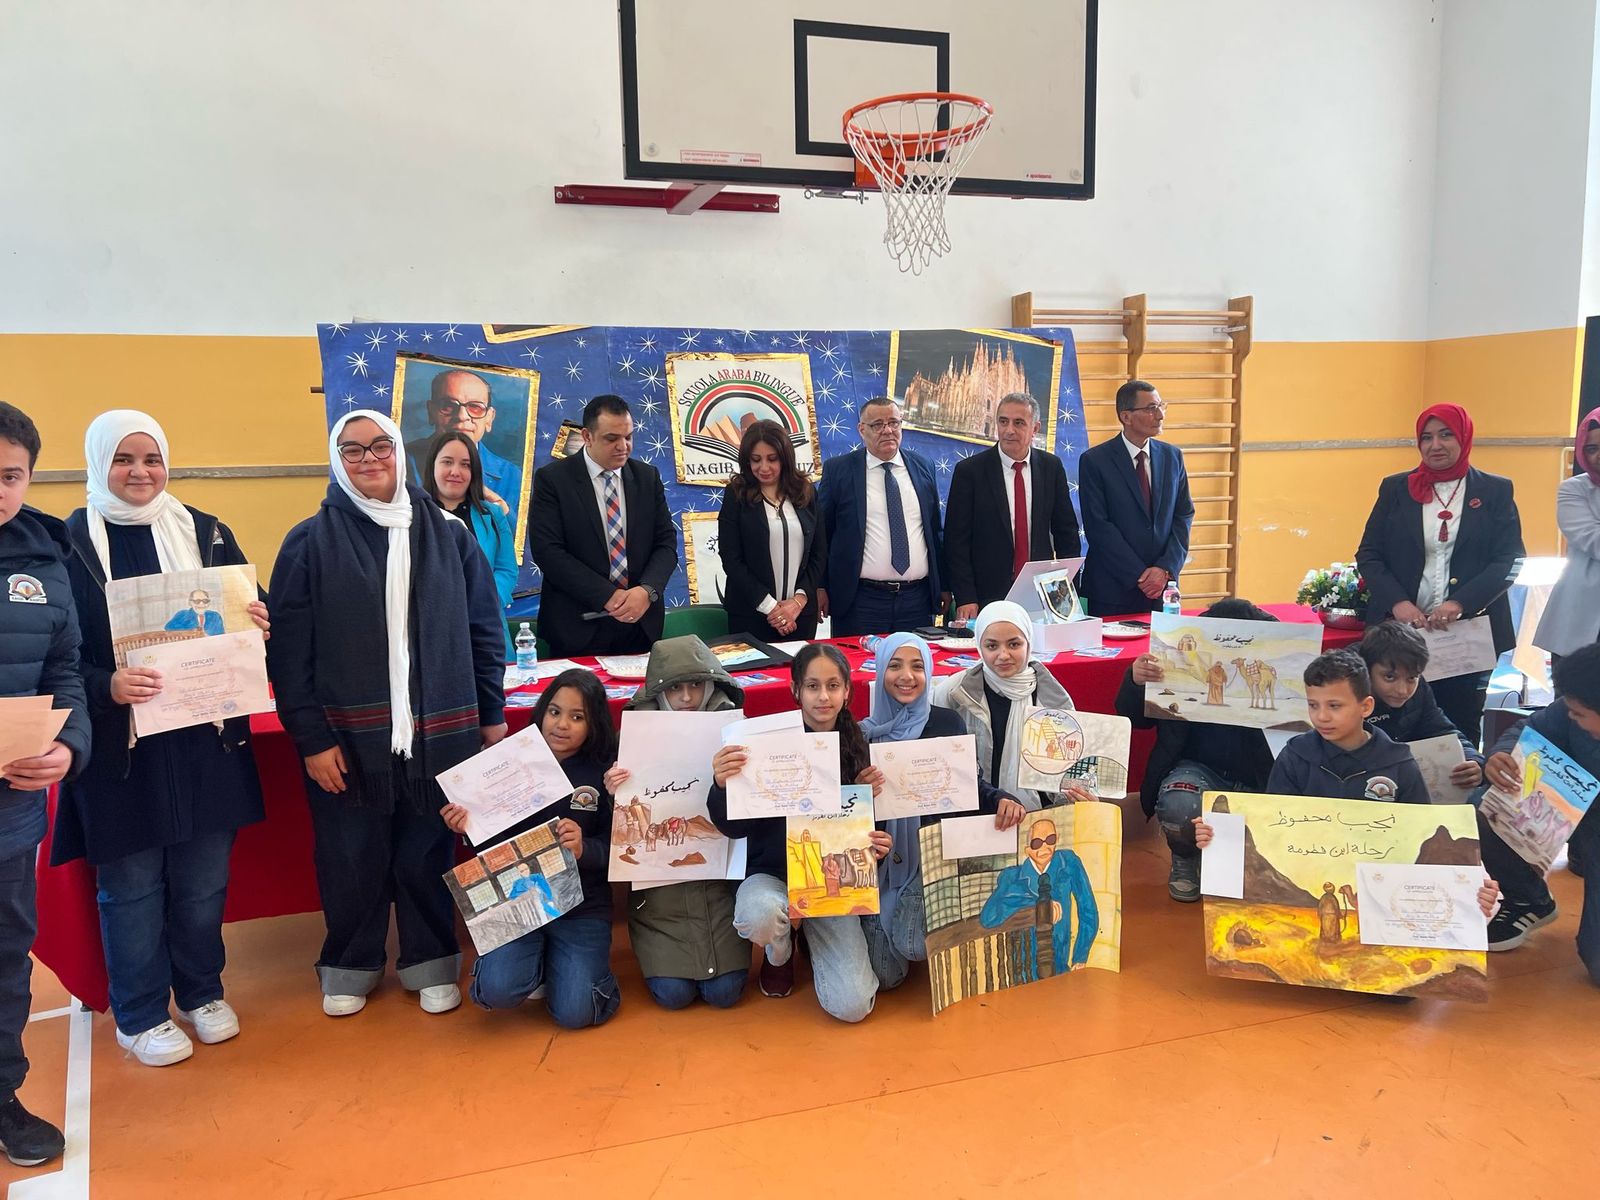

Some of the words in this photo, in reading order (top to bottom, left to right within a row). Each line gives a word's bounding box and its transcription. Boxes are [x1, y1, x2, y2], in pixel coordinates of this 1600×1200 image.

[678, 373, 719, 408] SCUOLA
[717, 369, 752, 381] ARABA
[753, 370, 806, 408] BILINGUE
[686, 461, 734, 475] NAGIB
[841, 793, 859, 813] نجي
[1268, 810, 1332, 828] محفوظ
[1336, 812, 1396, 833] نجيب
[1330, 842, 1349, 858] ابن
